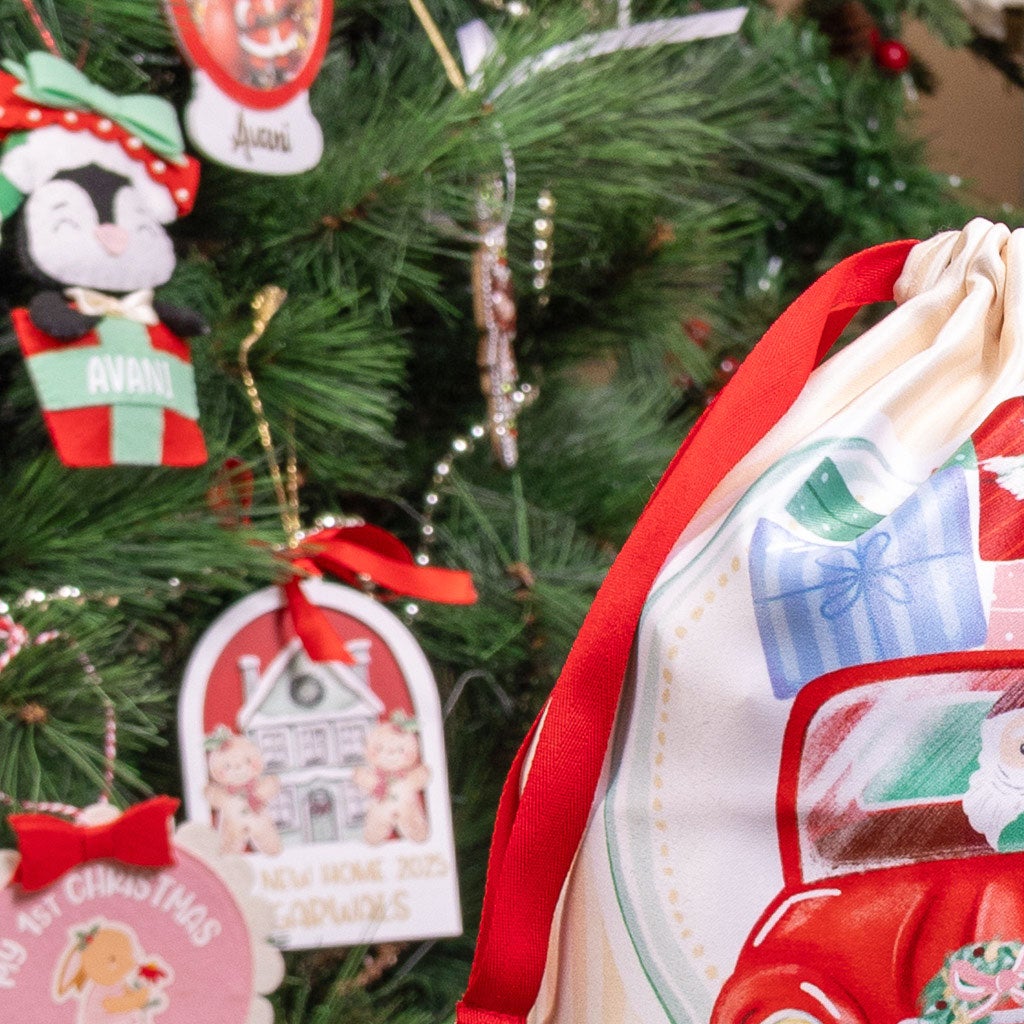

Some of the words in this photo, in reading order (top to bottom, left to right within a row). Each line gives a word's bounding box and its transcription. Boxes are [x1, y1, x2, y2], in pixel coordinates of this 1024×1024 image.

[85, 354, 175, 400] AVANI
[260, 864, 312, 892] NEW
[320, 858, 383, 884] HOME
